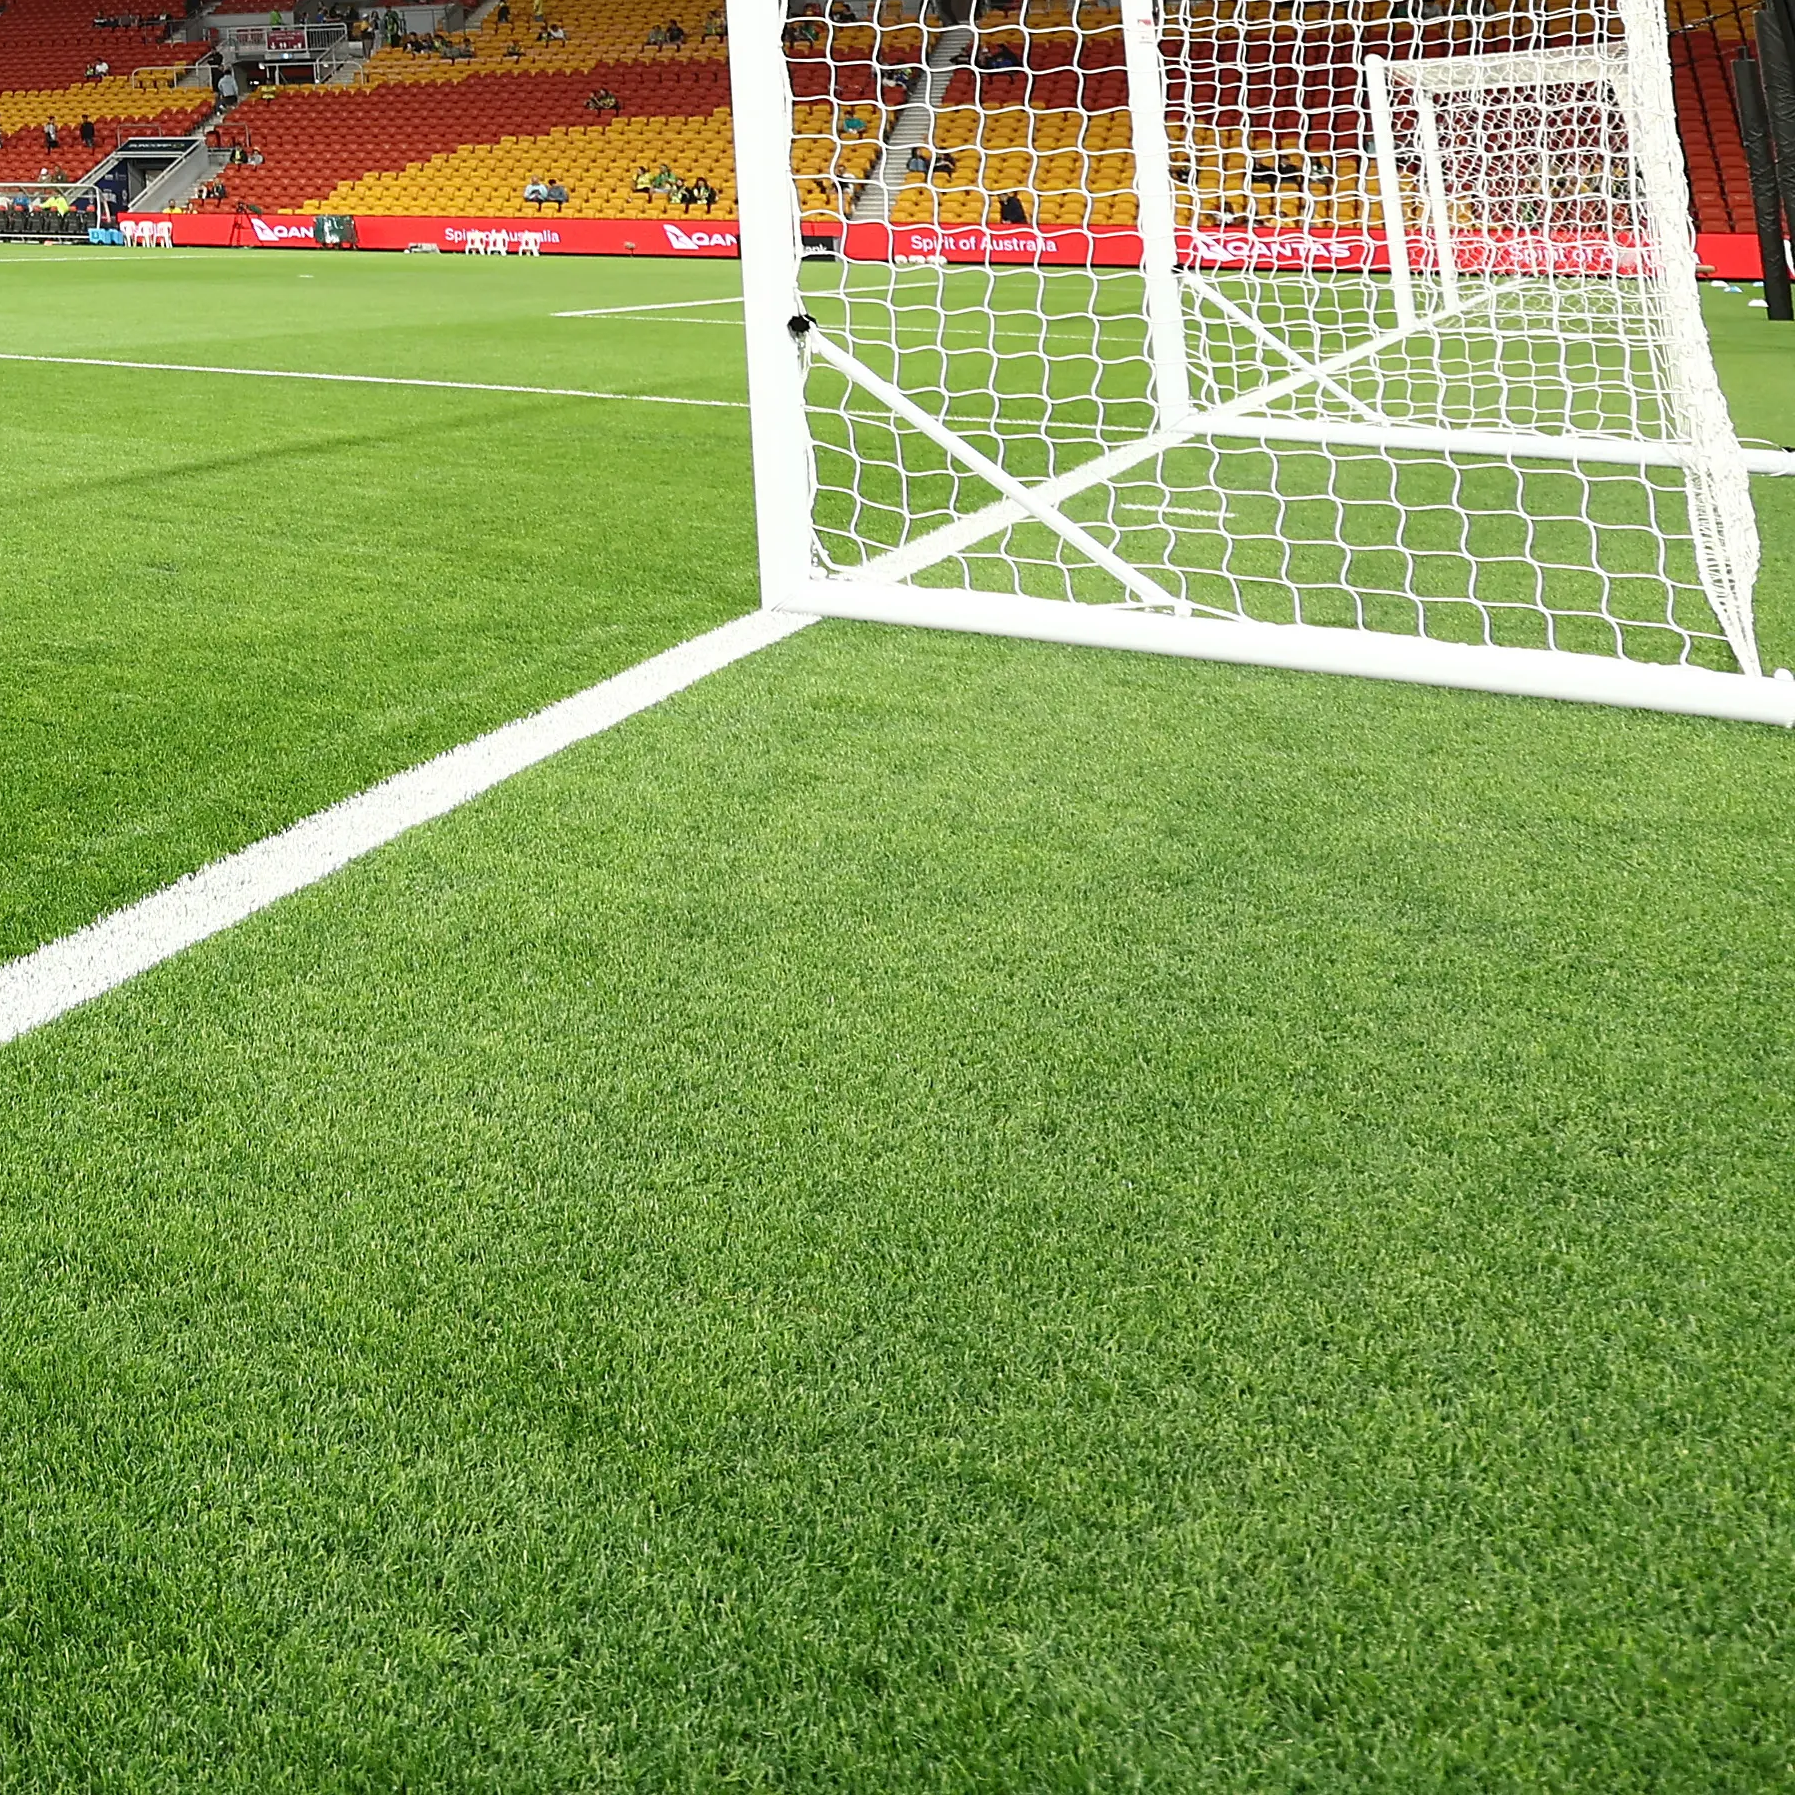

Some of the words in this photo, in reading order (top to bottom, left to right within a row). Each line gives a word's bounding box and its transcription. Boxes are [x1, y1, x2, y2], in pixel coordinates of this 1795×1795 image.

[273, 226, 315, 239] QAN
[691, 232, 738, 246] QAN
[959, 235, 976, 250] of
[980, 236, 1057, 252] Austraia
